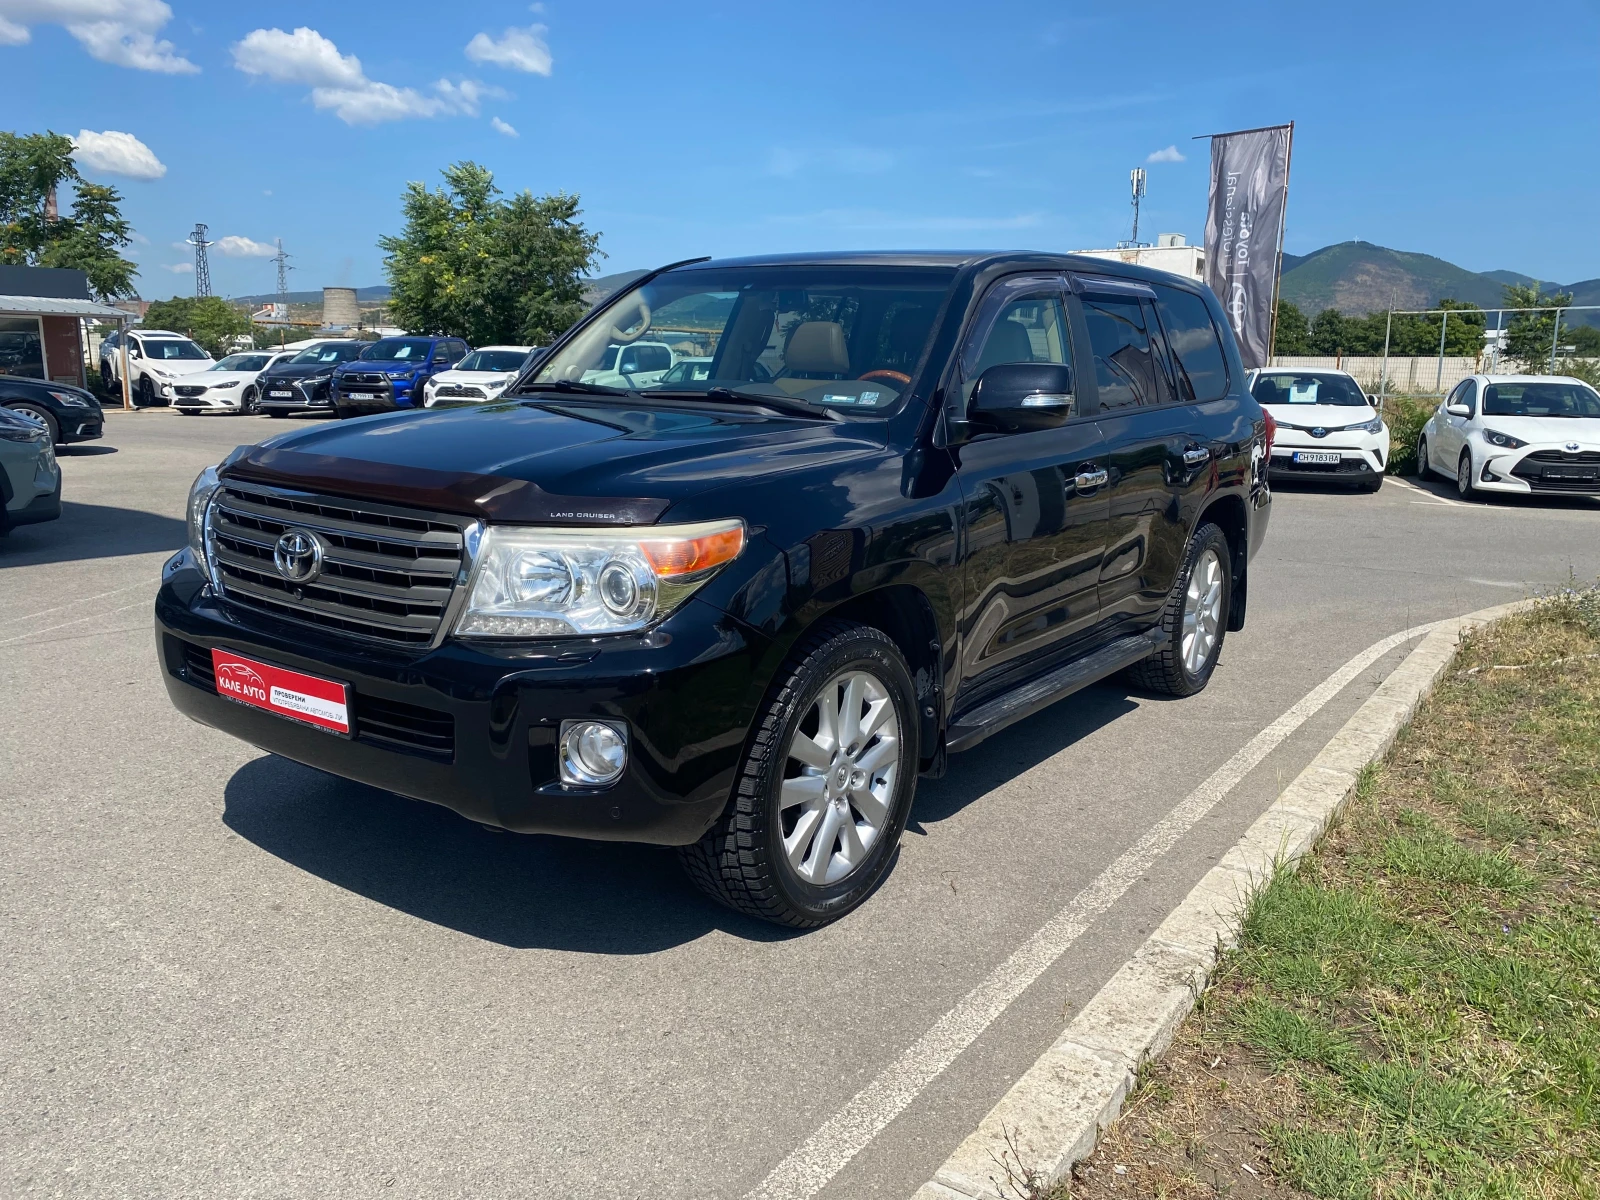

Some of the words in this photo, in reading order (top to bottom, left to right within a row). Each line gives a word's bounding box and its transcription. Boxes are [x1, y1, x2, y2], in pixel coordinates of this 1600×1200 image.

[219, 676, 241, 692] КАЛЕ
[243, 684, 266, 701] АУТО
[274, 689, 306, 703] ПРОВЕРЕНИ
